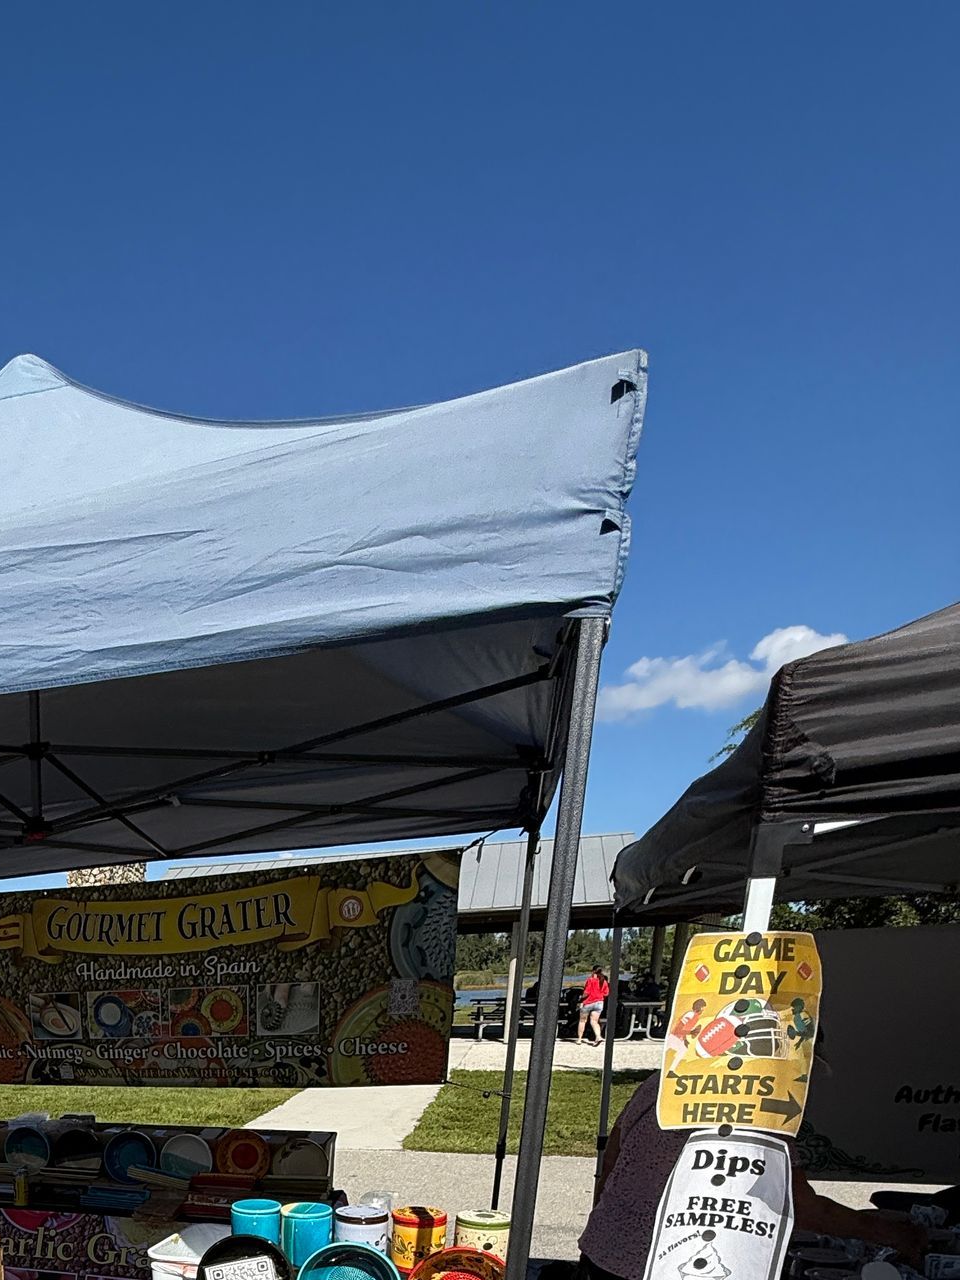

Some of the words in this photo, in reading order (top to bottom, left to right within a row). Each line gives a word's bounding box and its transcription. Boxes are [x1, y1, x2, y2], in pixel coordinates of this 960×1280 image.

[46, 906, 167, 946] GOURMET
[177, 893, 296, 940] GRATER
[713, 938, 796, 962] GAME
[76, 959, 174, 981] Handmade
[179, 962, 201, 978] in
[203, 955, 261, 984] Spain
[718, 971, 787, 995] DAY
[25, 1044, 83, 1064] Nutmeg
[96, 1043, 149, 1064] Ginger
[163, 1042, 248, 1060] Chocolate
[264, 1039, 322, 1062] Spices
[339, 1037, 409, 1056] Cheese
[674, 1074, 775, 1096] STARTS
[682, 1103, 756, 1123] HERE
[918, 1112, 960, 1132] Fla
[691, 1149, 766, 1177] Dips
[686, 1196, 752, 1216] FREE
[665, 1212, 776, 1239] SAMPLES!
